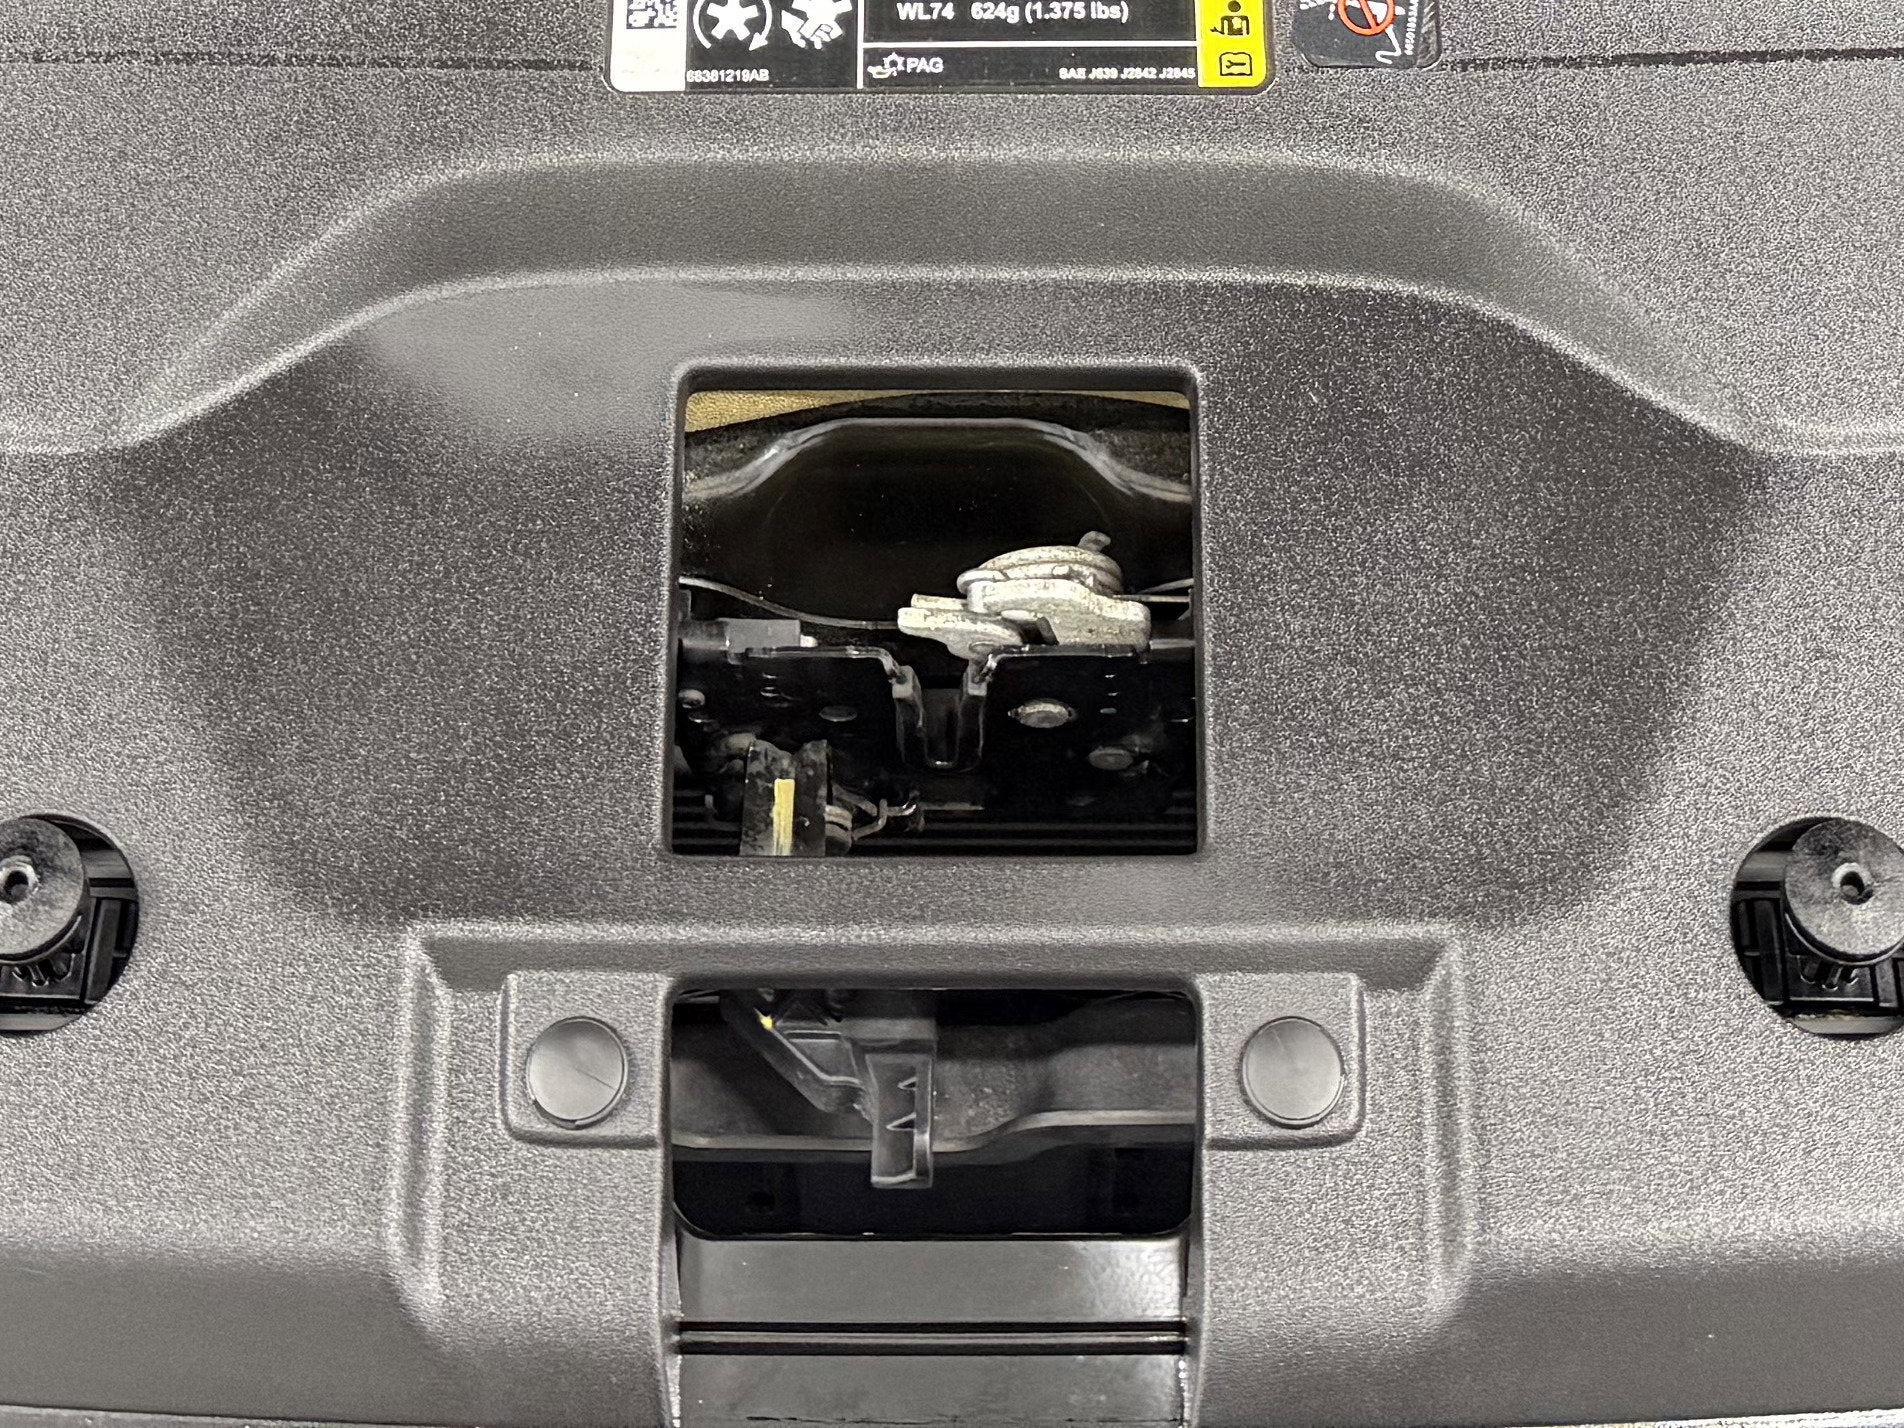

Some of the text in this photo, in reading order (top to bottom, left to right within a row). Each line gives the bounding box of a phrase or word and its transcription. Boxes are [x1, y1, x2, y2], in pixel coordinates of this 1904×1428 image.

[896, 1, 1130, 24] WL74 624g (1.375 lbs)
[907, 56, 944, 74] PAG
